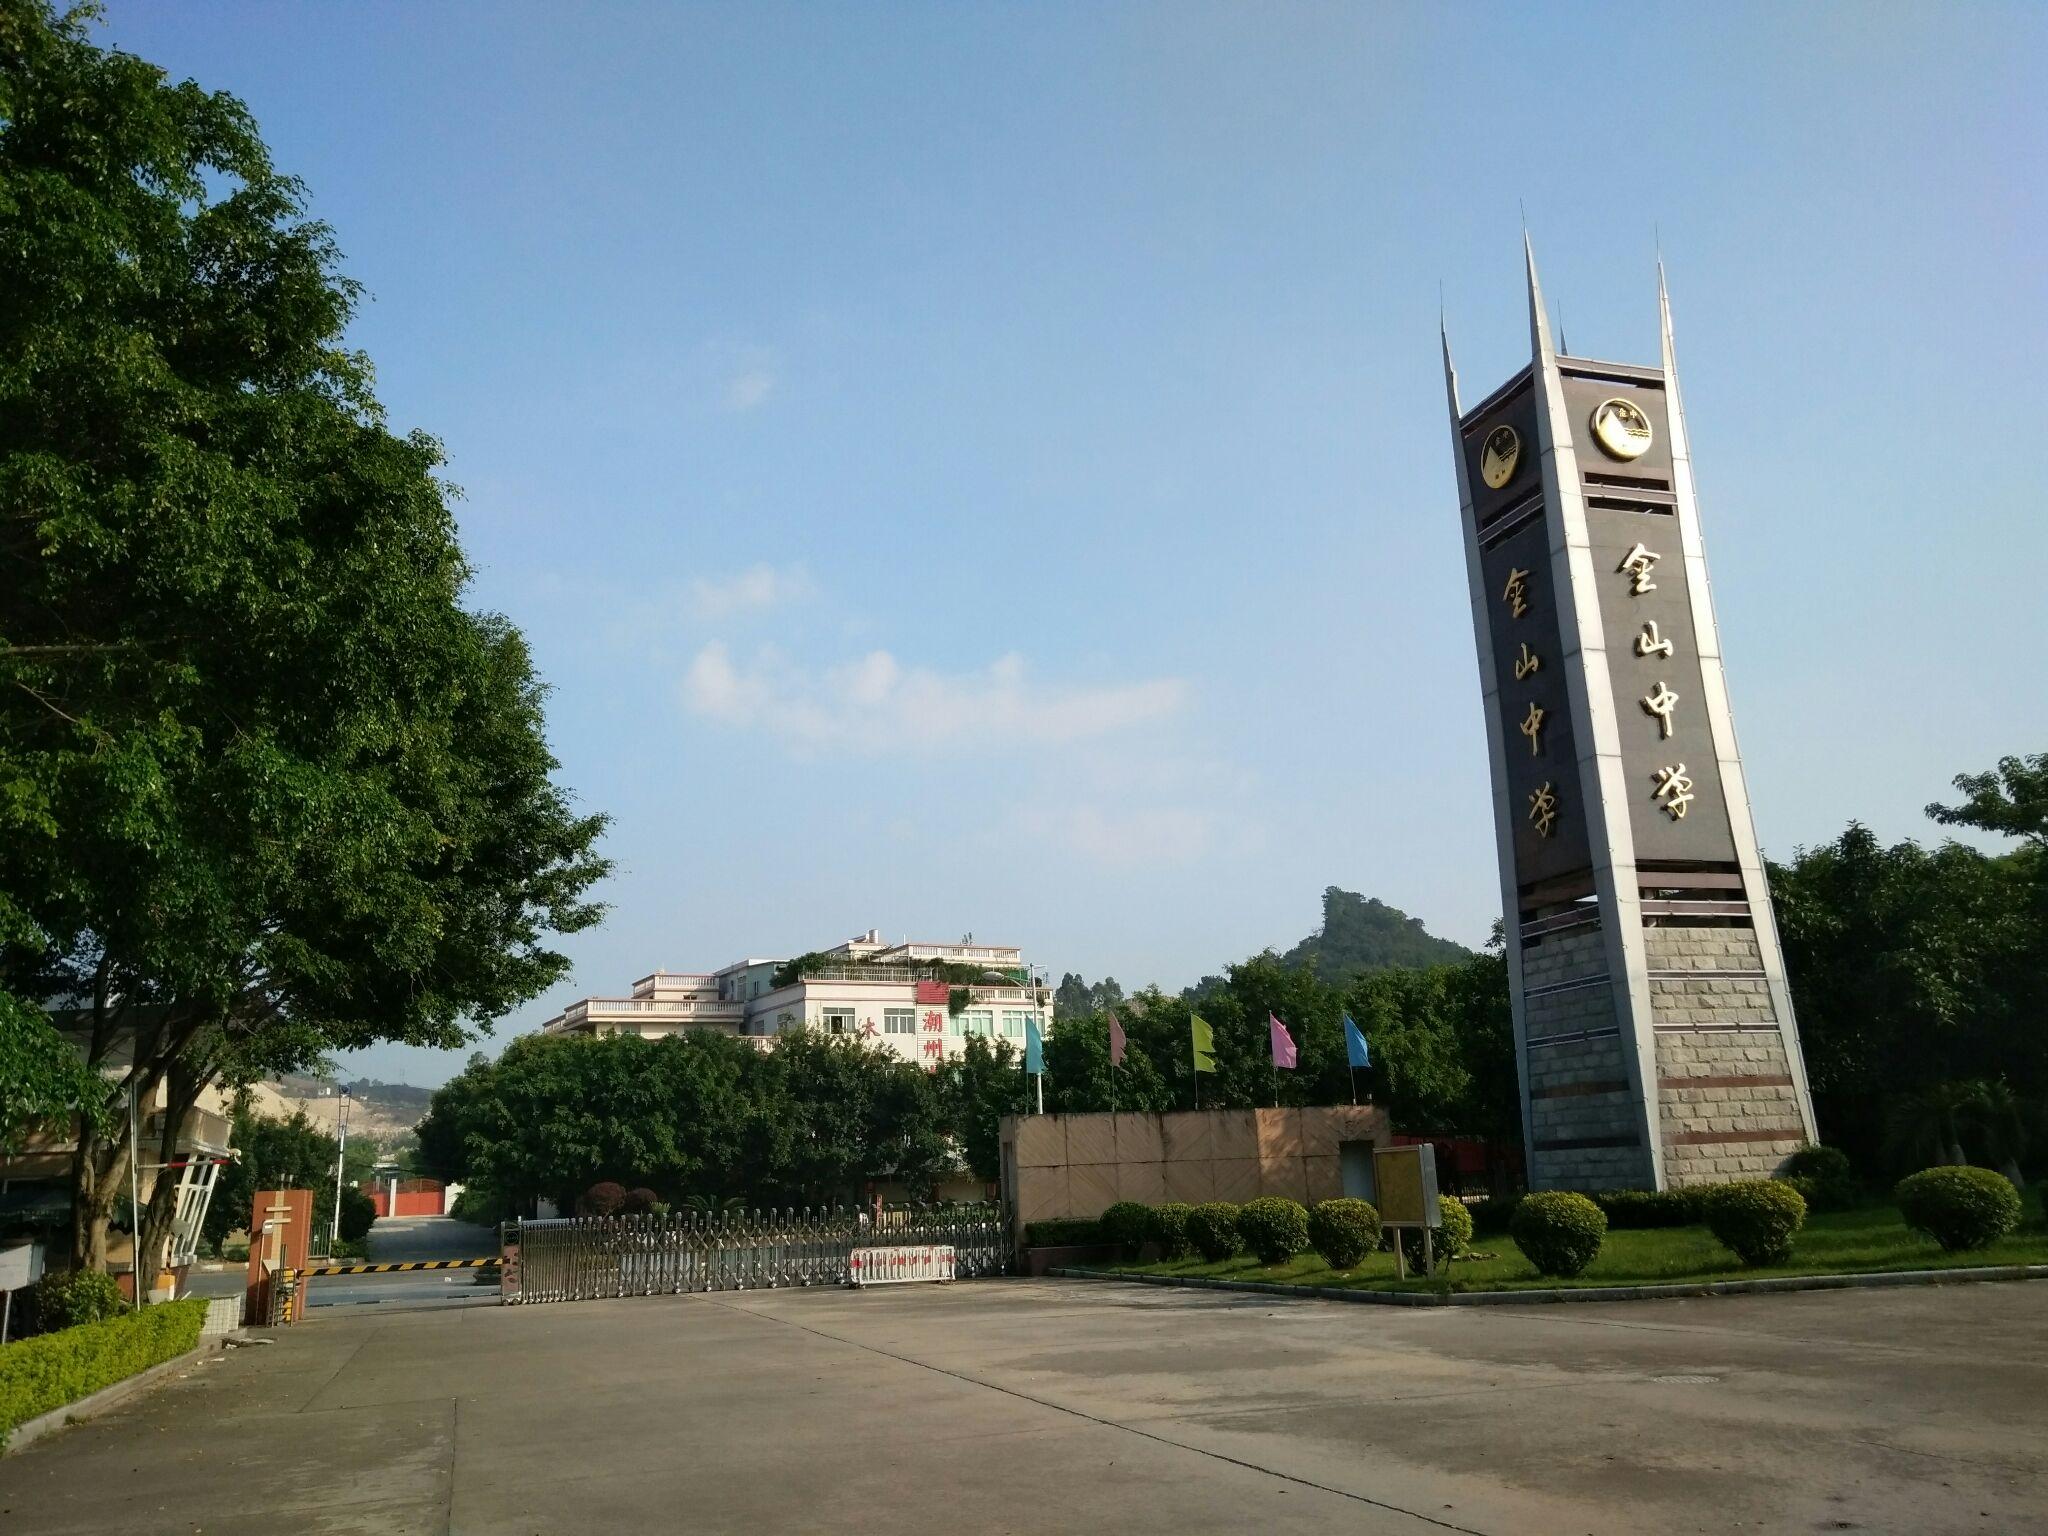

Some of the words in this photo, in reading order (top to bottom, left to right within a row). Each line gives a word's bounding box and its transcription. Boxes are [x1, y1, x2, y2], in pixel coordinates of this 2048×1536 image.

[1503, 567, 1558, 839] 金山中学
[1623, 543, 1695, 820] 金山中学
[923, 1009, 944, 1074] 潮州
